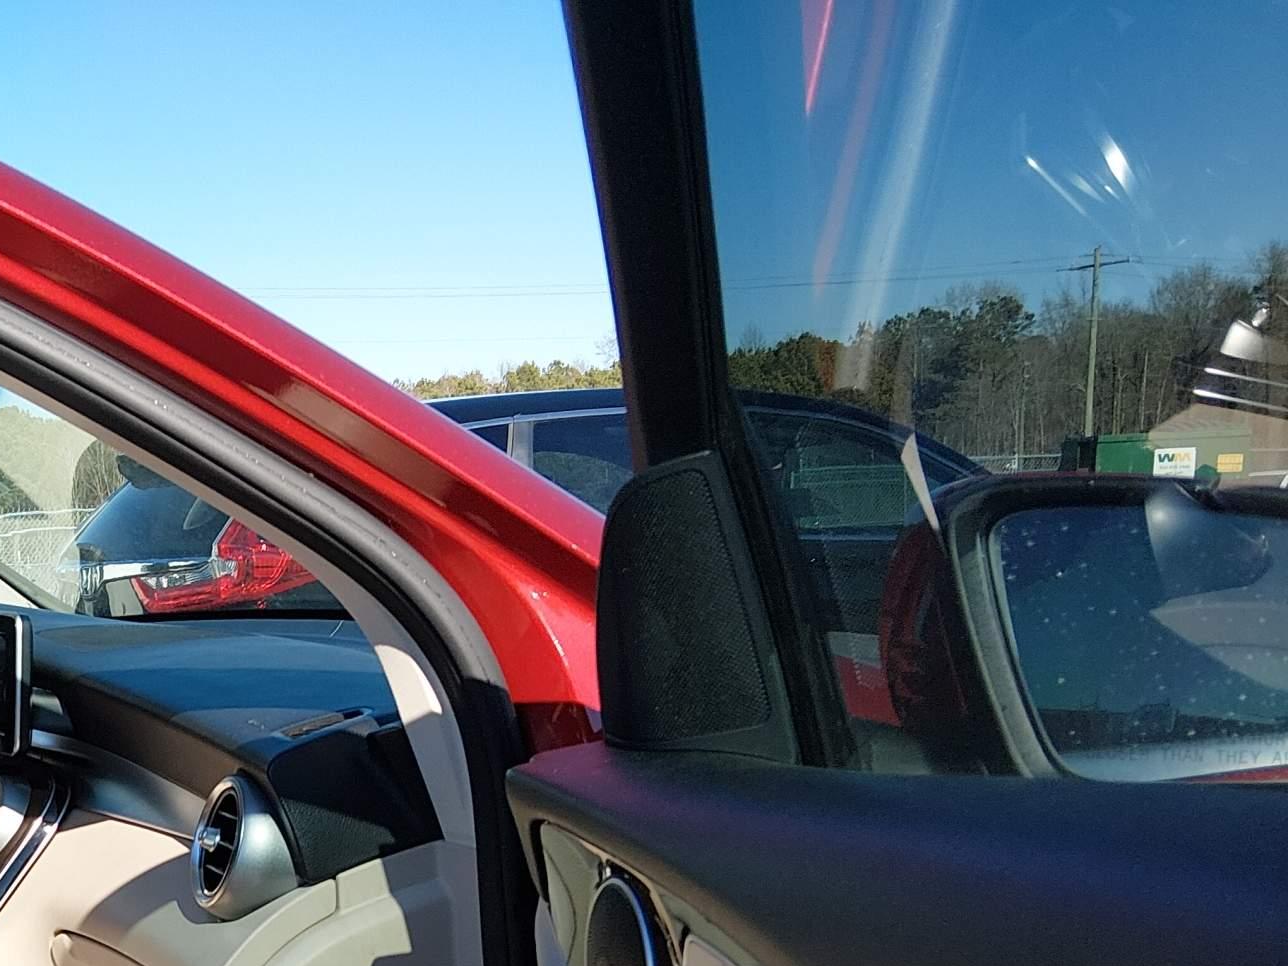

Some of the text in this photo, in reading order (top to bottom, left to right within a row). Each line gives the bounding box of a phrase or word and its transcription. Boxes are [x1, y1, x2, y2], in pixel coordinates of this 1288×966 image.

[1158, 453, 1192, 463] WM
[1161, 747, 1203, 762] THAN
[1215, 749, 1260, 765] THEY
[1272, 751, 1288, 766] A
